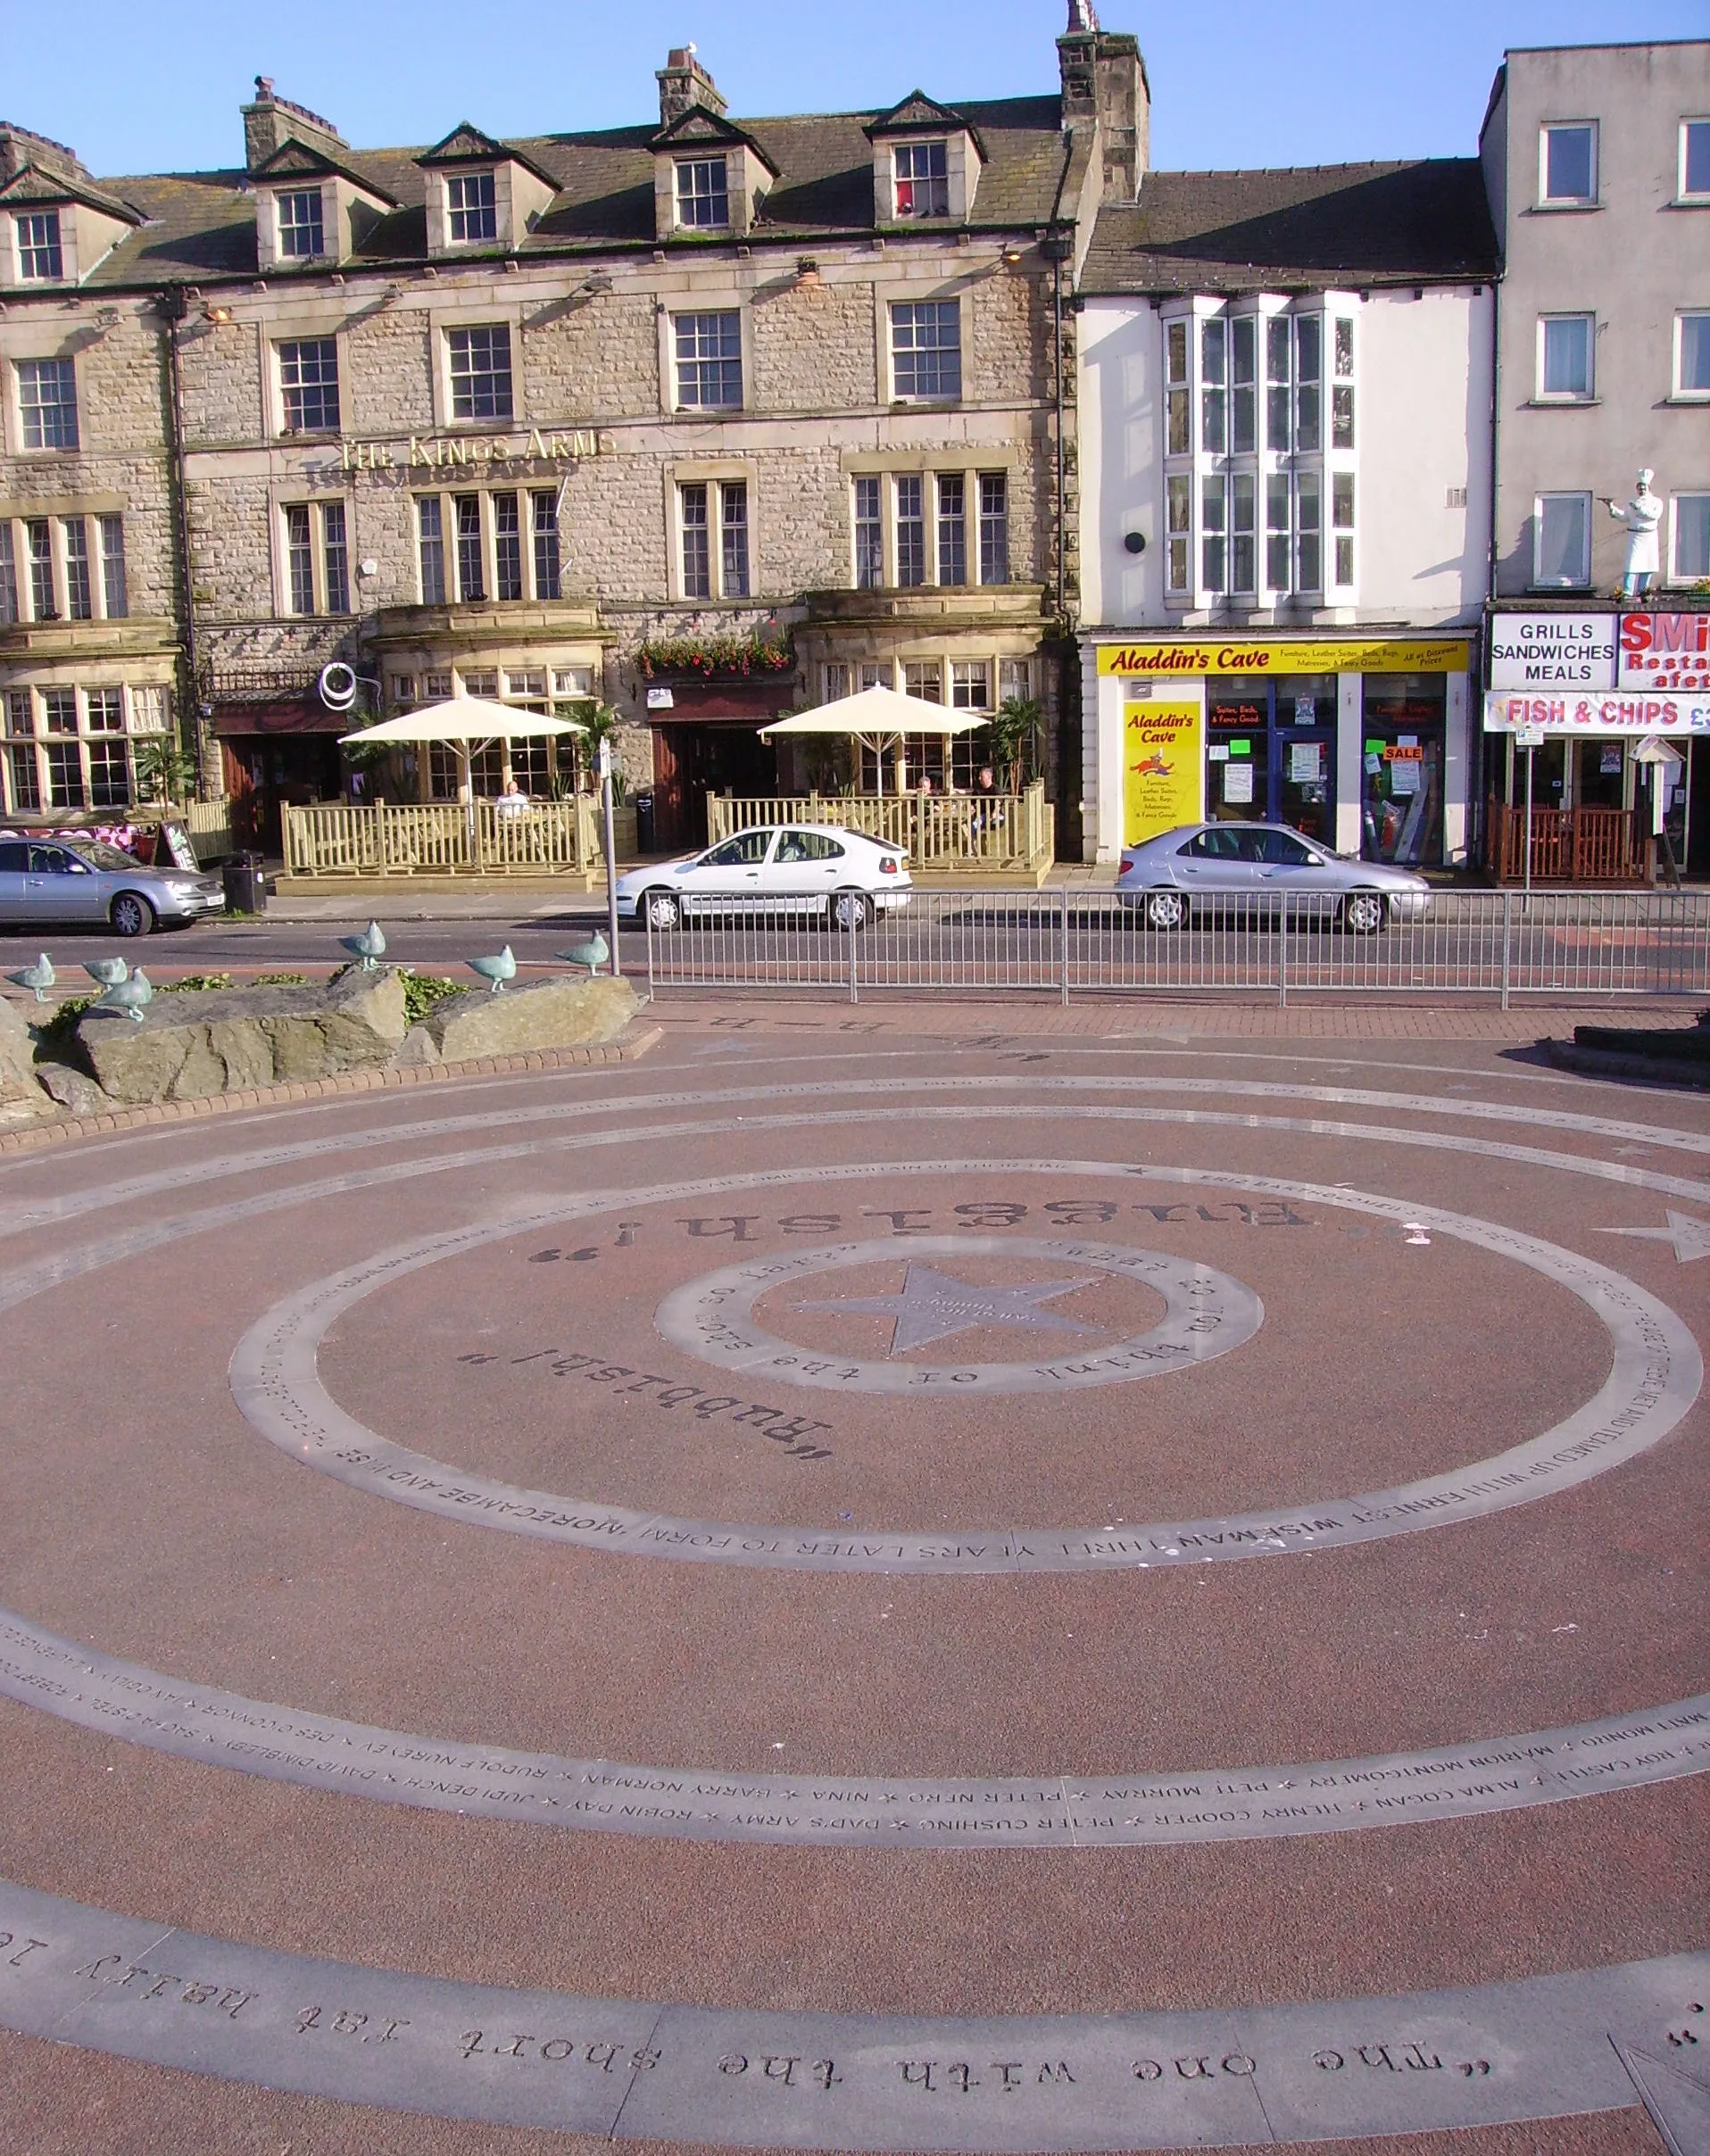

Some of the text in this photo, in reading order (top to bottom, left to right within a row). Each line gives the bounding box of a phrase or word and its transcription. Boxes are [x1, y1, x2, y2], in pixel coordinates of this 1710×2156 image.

[342, 428, 618, 469] THE KINGS ARMS
[1520, 624, 1593, 639] GRILLS
[1110, 647, 1270, 670] Aladdin's Cave
[1492, 644, 1614, 659] SANDWICHES
[1525, 665, 1591, 680] MEALS
[1128, 714, 1193, 728] Aladdin's
[1507, 700, 1565, 724] FISH
[1575, 701, 1592, 724] &
[1599, 701, 1679, 726] CHIPS
[1141, 730, 1176, 743] Cave
[1386, 747, 1421, 759] SALE
[698, 1287, 736, 1305] so
[1177, 1278, 1215, 1298] do
[1183, 1305, 1225, 1334] you
[693, 1314, 754, 1351] show
[772, 1356, 859, 1381] the
[1027, 1343, 1191, 1381] think
[909, 1372, 978, 1385] of
[1611, 1407, 1647, 1428] AND
[1551, 1428, 1626, 1464] TEAMED
[1527, 1463, 1563, 1477] UP
[387, 1471, 444, 1491] AND
[1462, 1472, 1532, 1497] WITH
[1351, 1492, 1467, 1524] ERNEST
[638, 1527, 733, 1549] FORM
[1175, 1518, 1344, 1548] WISEMAN
[743, 1538, 780, 1554] TO
[796, 1543, 903, 1558] LATER
[918, 1545, 1035, 1558] YEARS
[1657, 1712, 1709, 1731] MATT
[295, 1728, 336, 1744] DES
[1581, 1726, 1656, 1747] MONRO
[221, 1738, 315, 1768] DIMBLEBY
[358, 1741, 458, 1767] NUREYEV
[1468, 1745, 1554, 1768] MARION
[1634, 1750, 1677, 1767] ROY
[316, 1760, 378, 1781] DAVID
[458, 1760, 550, 1779] RUDOLF
[1309, 1762, 1465, 1787] MONTGOMERY
[1553, 1760, 1631, 1782] CASTLE
[402, 1777, 478, 1797] DENCH
[581, 1773, 685, 1793] NORMAN
[690, 1785, 771, 1798] BARRY
[1457, 1779, 1520, 1797] ALMA
[481, 1788, 536, 1804] JUDI
[812, 1790, 870, 1803] NINA
[908, 1792, 975, 1804] NERO
[984, 1791, 1062, 1804] PETER
[1100, 1787, 1201, 1801] MURRAY
[1374, 1789, 1455, 1810] COGAN
[569, 1799, 614, 1814] DAY
[618, 1804, 693, 1821] ROBIN
[1261, 1803, 1341, 1820] HENRY
[728, 1814, 801, 1828] ARMY
[809, 1817, 880, 1830] DAD'S
[918, 1818, 1028, 1831] CUSHING
[1034, 1817, 1115, 1830] PETER
[1153, 1810, 1251, 1826] COOPER
[70, 1954, 261, 2019] hairy
[290, 2005, 411, 2045] fat
[454, 2029, 662, 2075] short
[714, 2053, 843, 2092] the
[893, 2060, 1078, 2094] with
[1129, 2055, 1257, 2084] one
